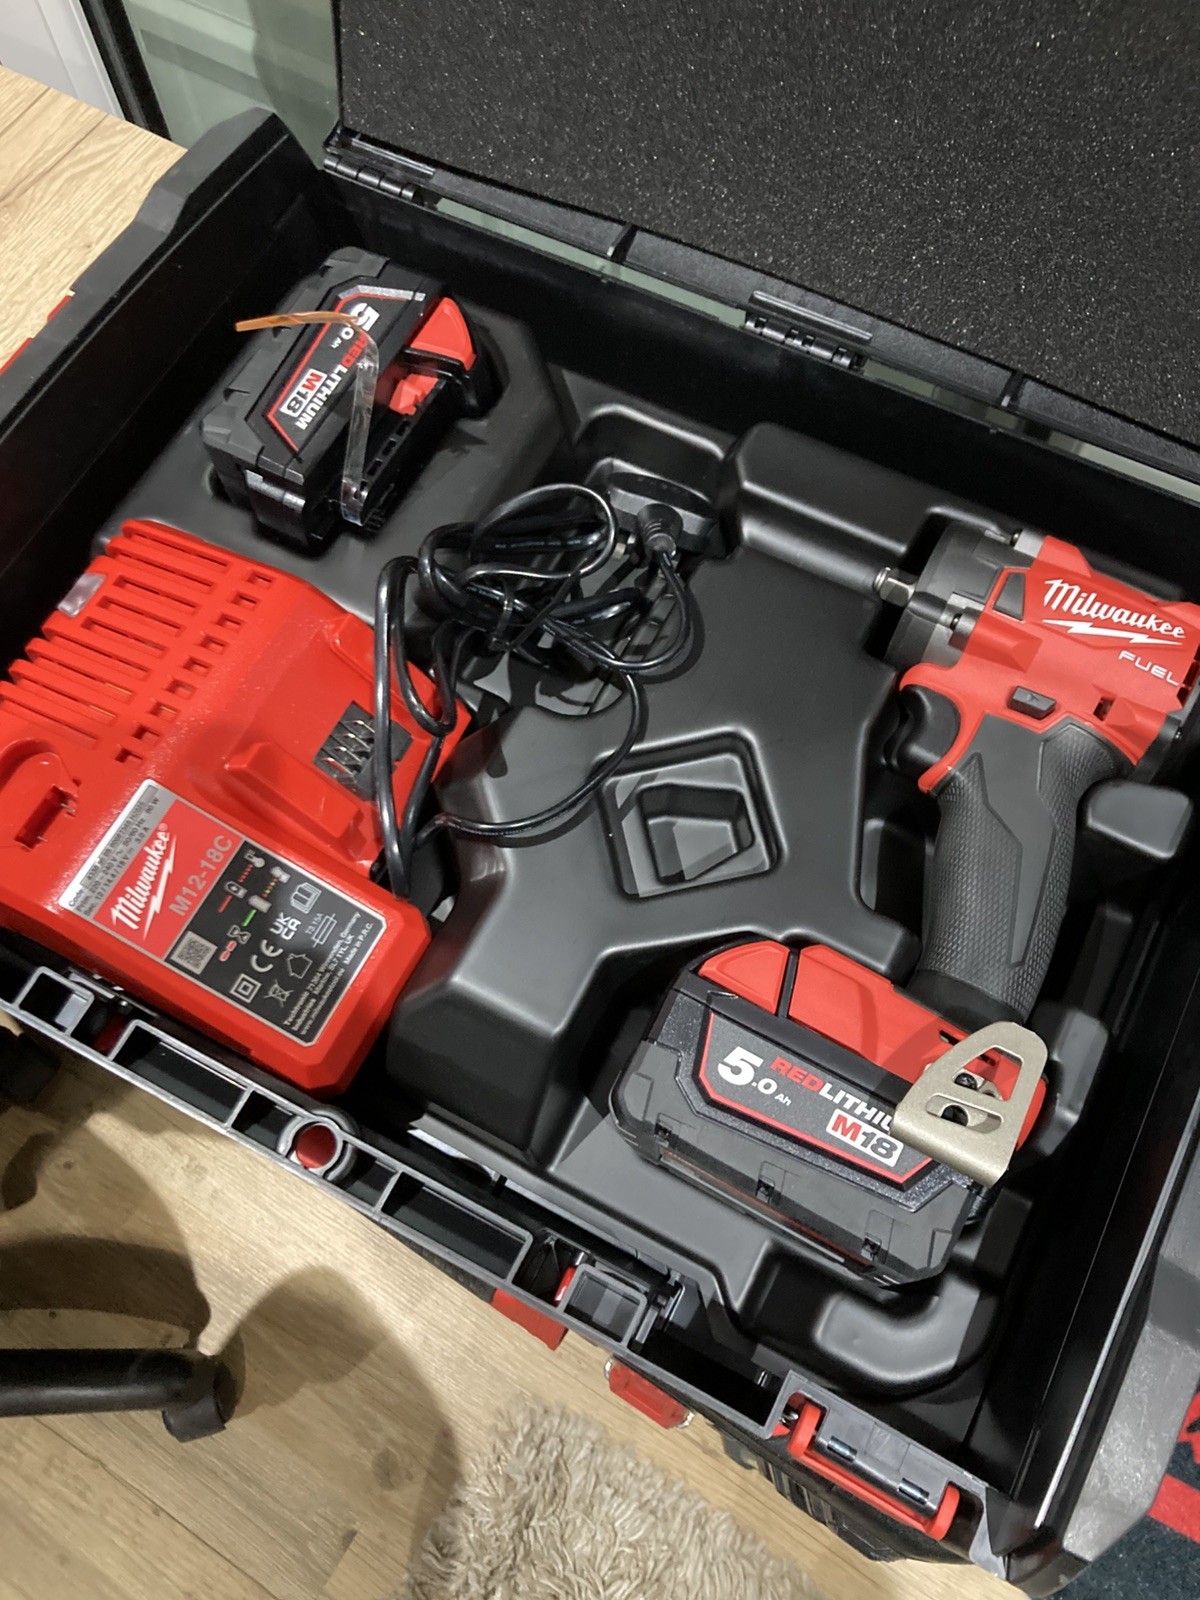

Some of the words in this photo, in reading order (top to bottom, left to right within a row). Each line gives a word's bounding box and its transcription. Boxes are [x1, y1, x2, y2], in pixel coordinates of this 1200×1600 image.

[341, 303, 380, 340] 50
[332, 337, 342, 349] Ah
[286, 372, 323, 413] M18
[1043, 579, 1186, 638] Milwaukee
[1118, 650, 1179, 686] FUEL
[104, 861, 114, 875] 240
[169, 835, 231, 916] M12-18C
[344, 948, 357, 964] Made
[717, 1046, 778, 1095] 5.0
[774, 1093, 792, 1106] Ah
[770, 1057, 892, 1132] REDLITHIU
[832, 1114, 899, 1161] M18
